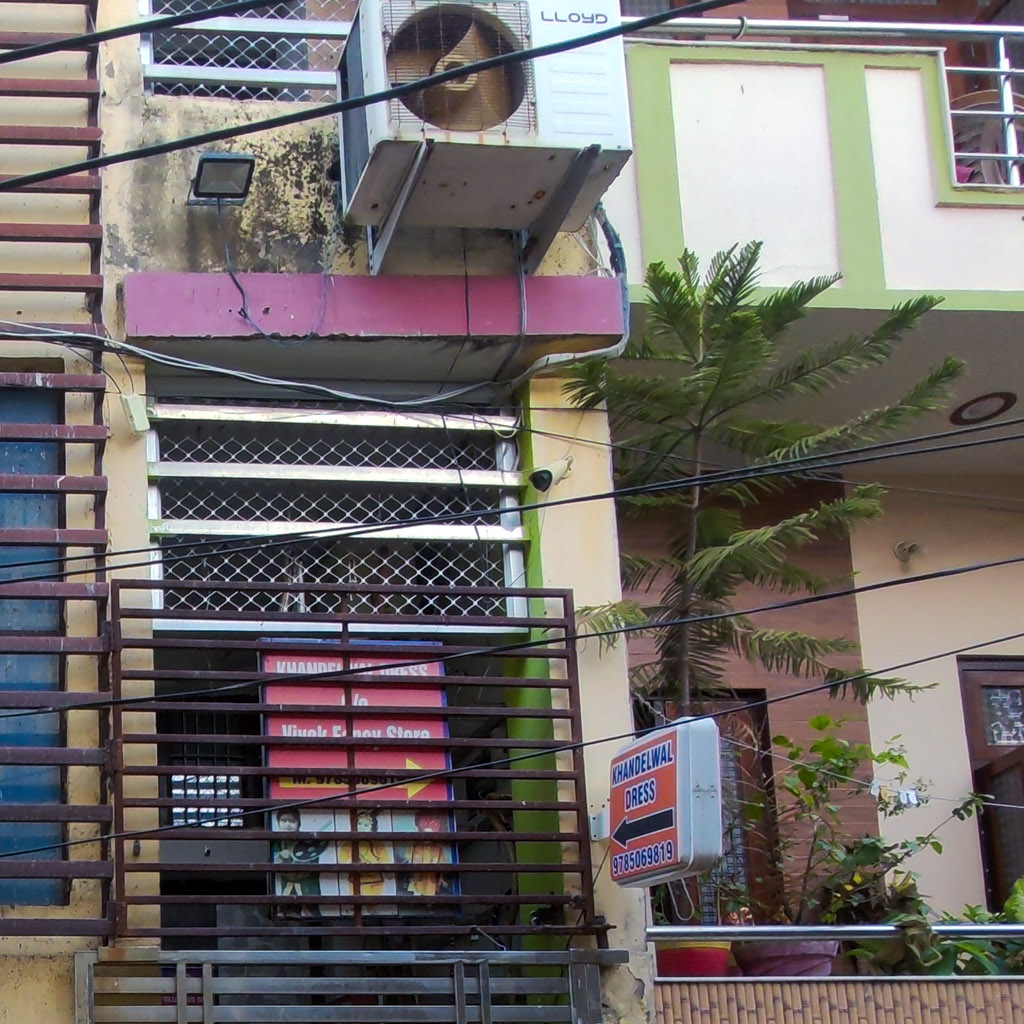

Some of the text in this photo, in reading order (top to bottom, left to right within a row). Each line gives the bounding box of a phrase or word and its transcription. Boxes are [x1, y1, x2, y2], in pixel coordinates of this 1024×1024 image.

[540, 10, 608, 24] LLOYD
[276, 661, 373, 675] KHANDE
[611, 740, 674, 788] KHANDELWAL
[624, 778, 656, 812] DRESS
[612, 840, 674, 876] 9785069819
